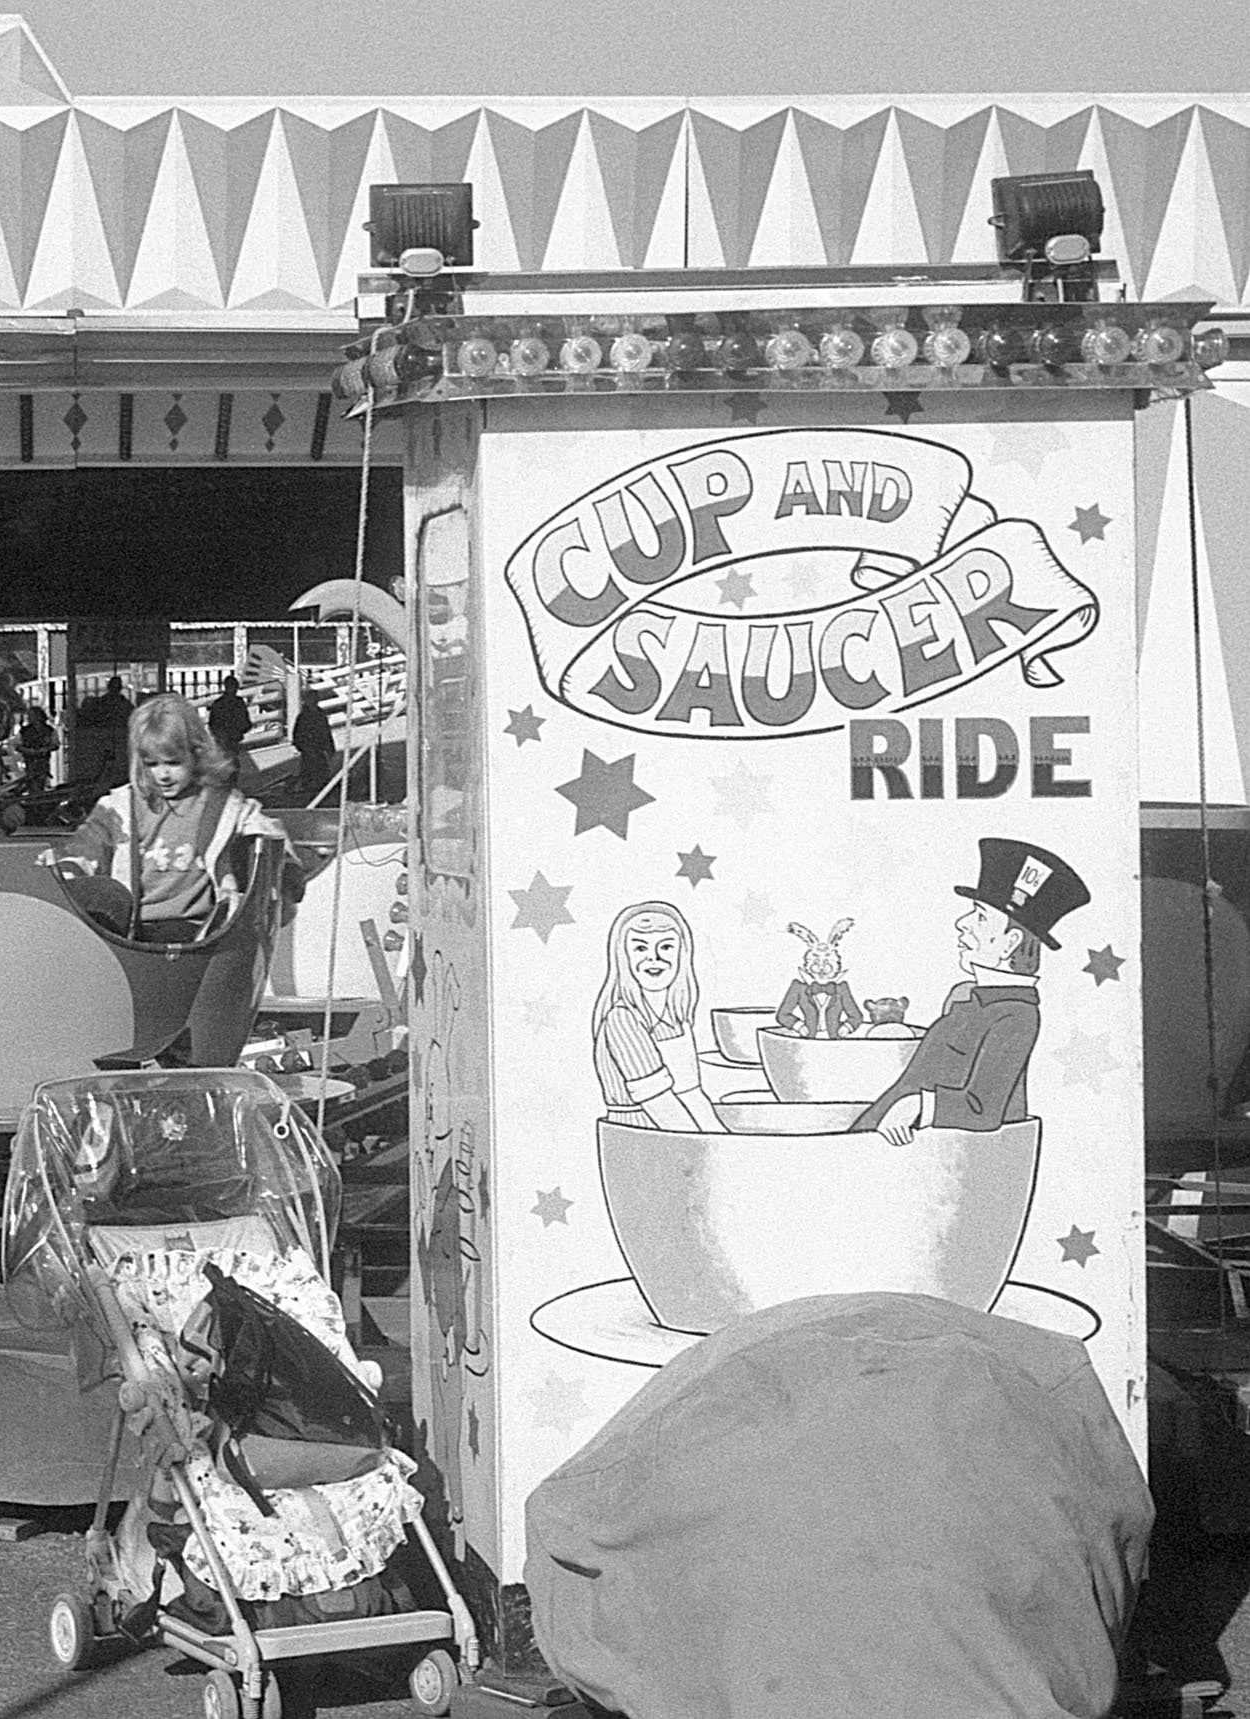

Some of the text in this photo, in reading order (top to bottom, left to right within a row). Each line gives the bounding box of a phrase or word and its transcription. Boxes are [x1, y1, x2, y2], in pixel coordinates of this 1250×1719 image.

[533, 449, 912, 627] CUP AND
[588, 547, 1058, 727] SAUCER
[850, 716, 1093, 800] RIDE
